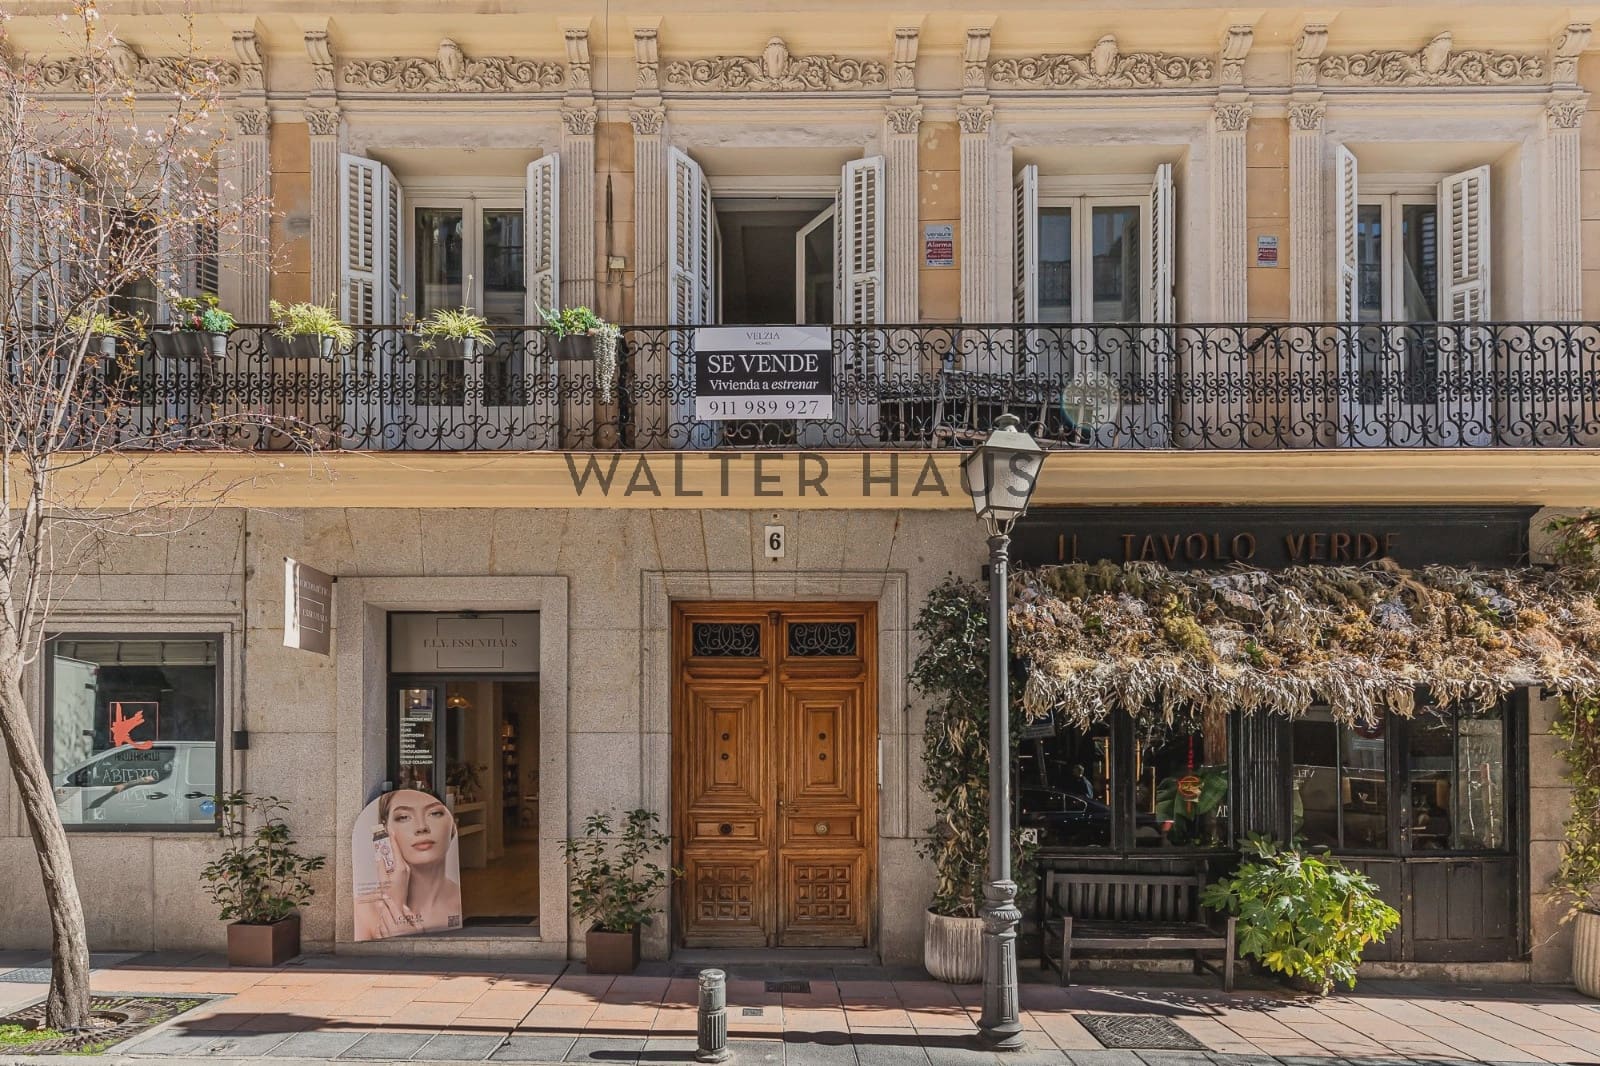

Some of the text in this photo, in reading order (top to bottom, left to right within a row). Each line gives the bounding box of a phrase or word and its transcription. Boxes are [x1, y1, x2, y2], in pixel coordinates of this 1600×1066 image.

[746, 332, 780, 340] VELZIA
[707, 353, 819, 374] SE VENDE
[709, 379, 819, 391] Vivienda a estrenar
[709, 400, 819, 416] 911 989 927
[769, 532, 781, 550] 6
[1121, 531, 1257, 561] TAVOLO
[1286, 531, 1402, 561] VERDE
[452, 639, 518, 648] ESSENTIALS
[102, 768, 160, 784] ABIERTO
